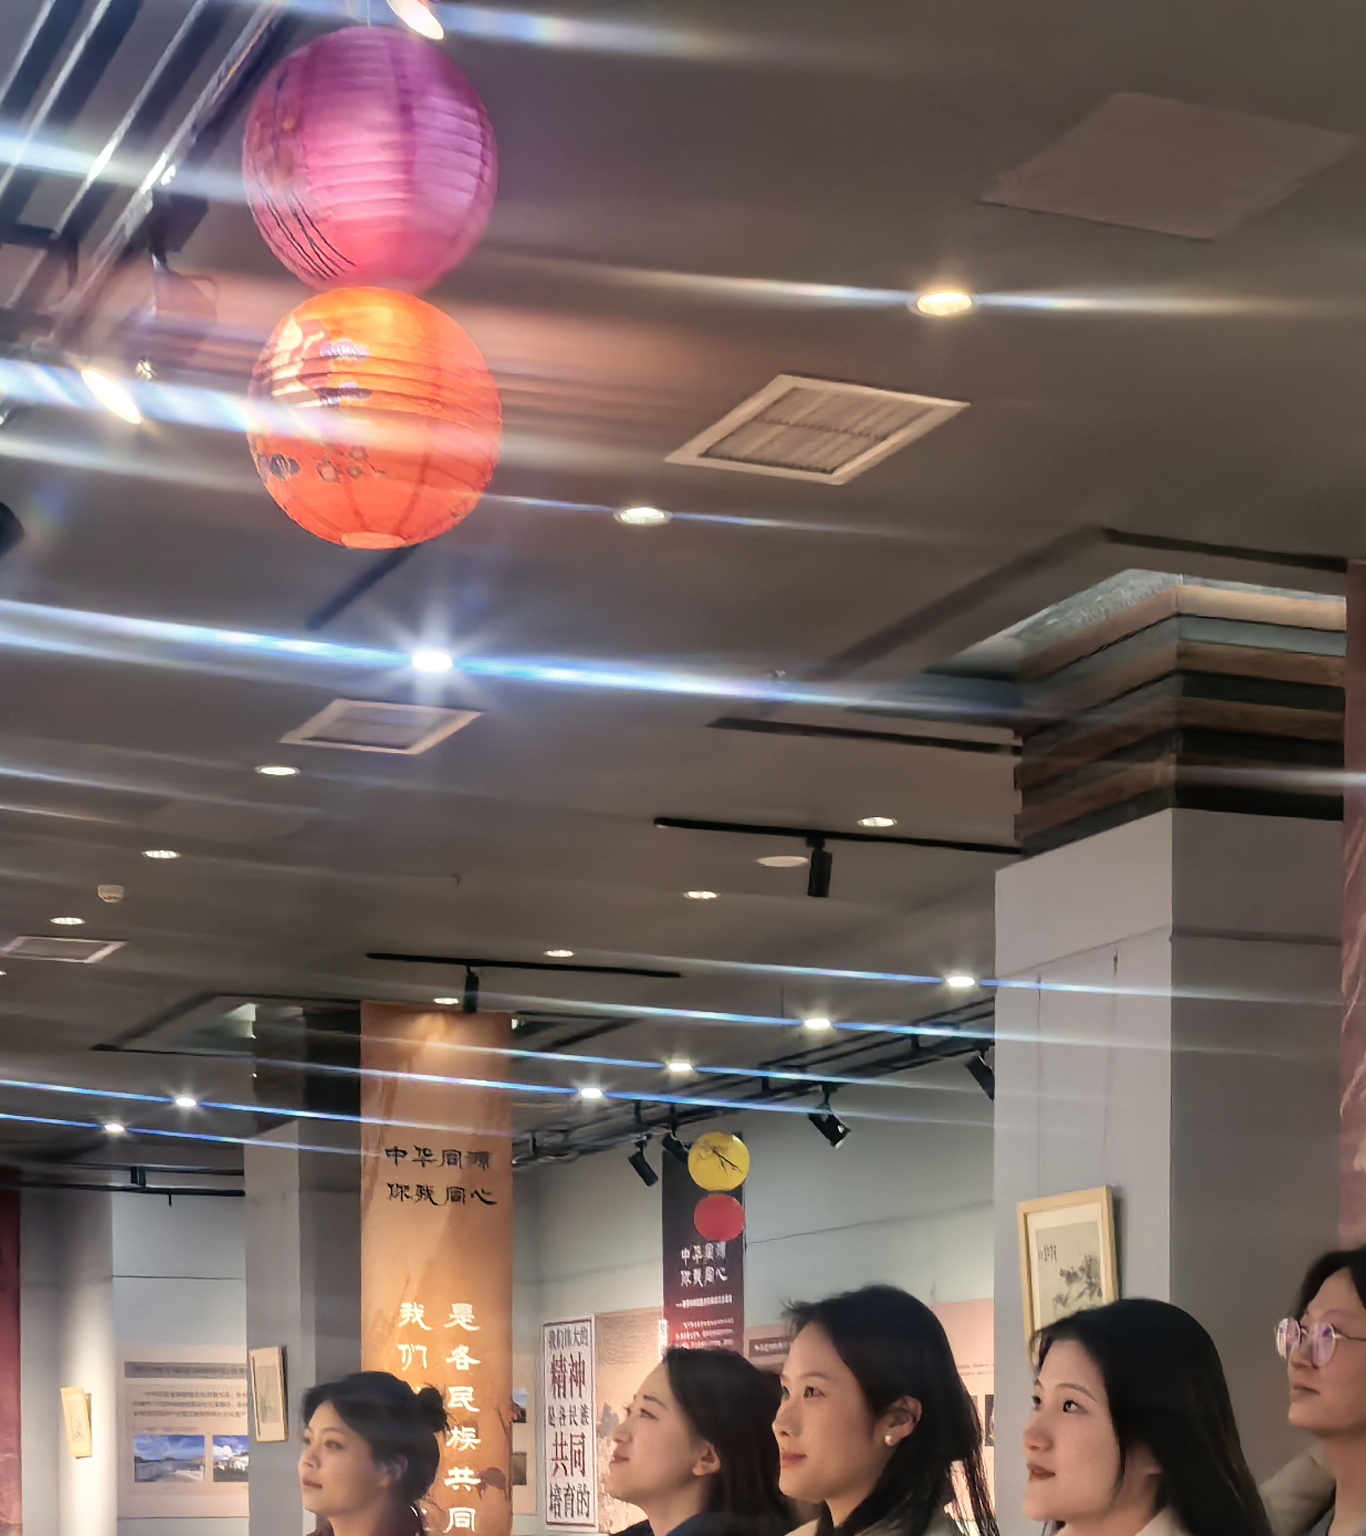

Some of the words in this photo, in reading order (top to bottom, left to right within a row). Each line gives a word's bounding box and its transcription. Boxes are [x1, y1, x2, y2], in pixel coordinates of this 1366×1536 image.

[384, 1145, 491, 1170] 中华同源
[387, 1183, 498, 1206] 你我同心
[397, 1302, 433, 1371] 我们
[550, 1351, 586, 1399] 精神
[550, 1431, 586, 1477] 共同
[549, 1482, 590, 1519] 培育的
